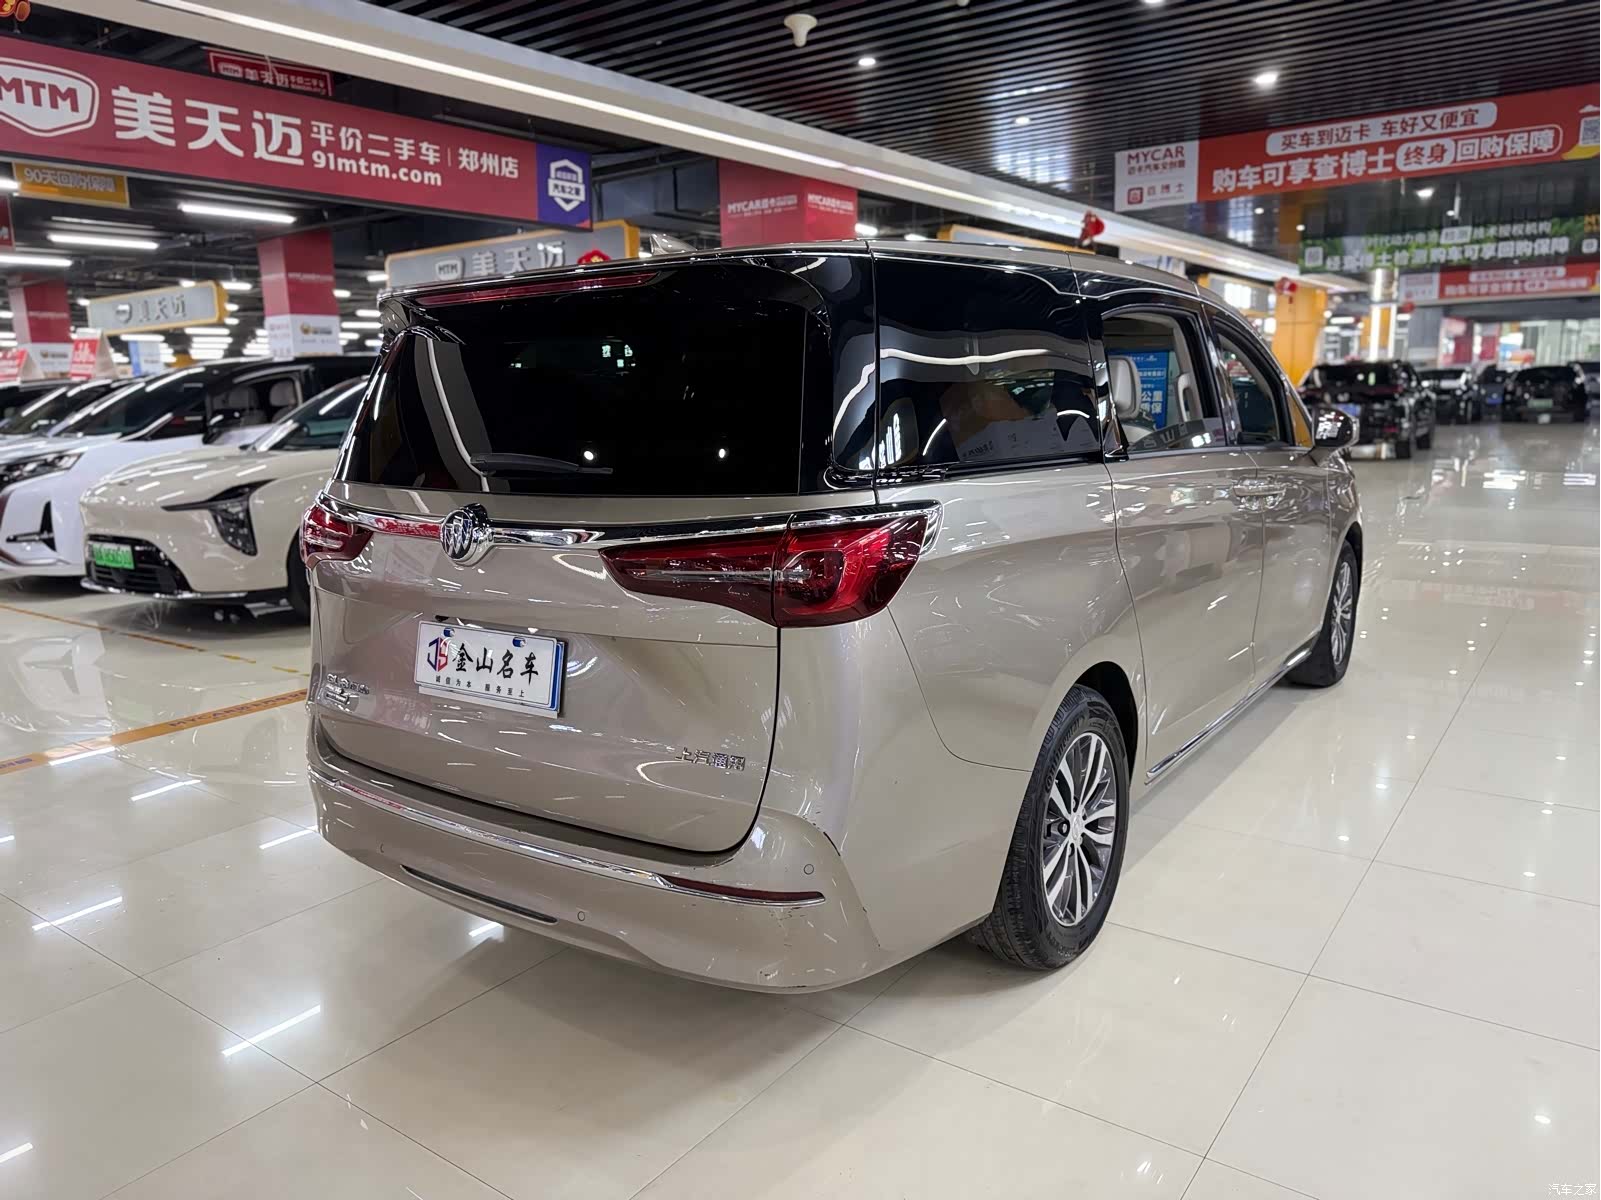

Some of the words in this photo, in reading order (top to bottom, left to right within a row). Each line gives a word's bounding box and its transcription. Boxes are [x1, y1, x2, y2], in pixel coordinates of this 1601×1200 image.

[0, 76, 80, 113] MTM
[111, 85, 304, 166] 美天迈
[1281, 124, 1371, 151] 买车到迈卡
[1380, 108, 1479, 138] 车好又便宜
[310, 120, 441, 166] 平价二手车
[458, 147, 519, 179] 郑州店
[1127, 145, 1185, 165] MYCAR
[312, 150, 442, 187] 91mtm.com
[471, 242, 567, 276] 美天迈
[451, 643, 539, 685] 金山名车
[435, 674, 472, 689] 诚信为本
[484, 685, 526, 698] 服务至上
[674, 746, 746, 771] 上汽通用
